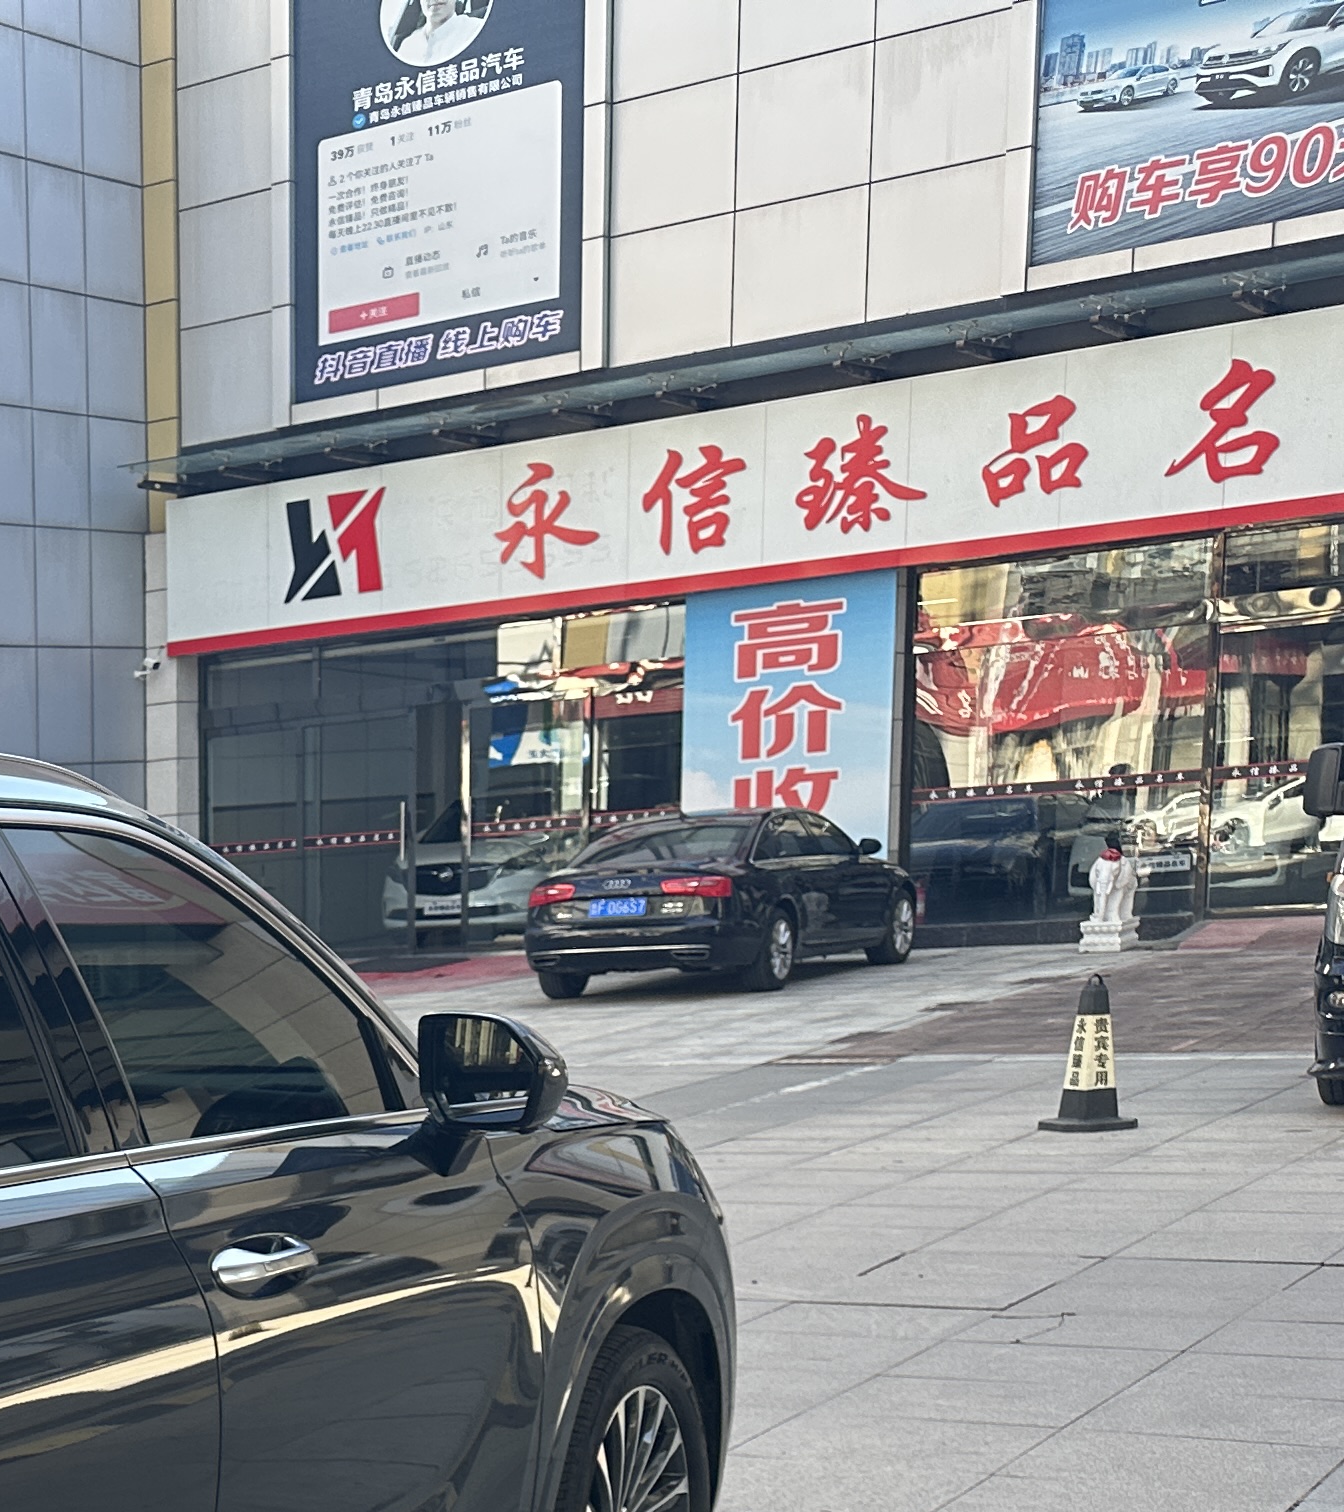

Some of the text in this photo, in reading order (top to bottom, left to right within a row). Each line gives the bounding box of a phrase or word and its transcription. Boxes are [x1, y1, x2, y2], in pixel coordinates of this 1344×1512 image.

[352, 47, 525, 112] 青岛永信臻品汽车
[314, 310, 564, 385] 抖音直播 线上购车
[494, 358, 1282, 580] 永信臻品名
[728, 597, 847, 814] 高价收
[1069, 1017, 1086, 1087] 永信臻品
[1094, 1017, 1110, 1087] 贵宾专用
